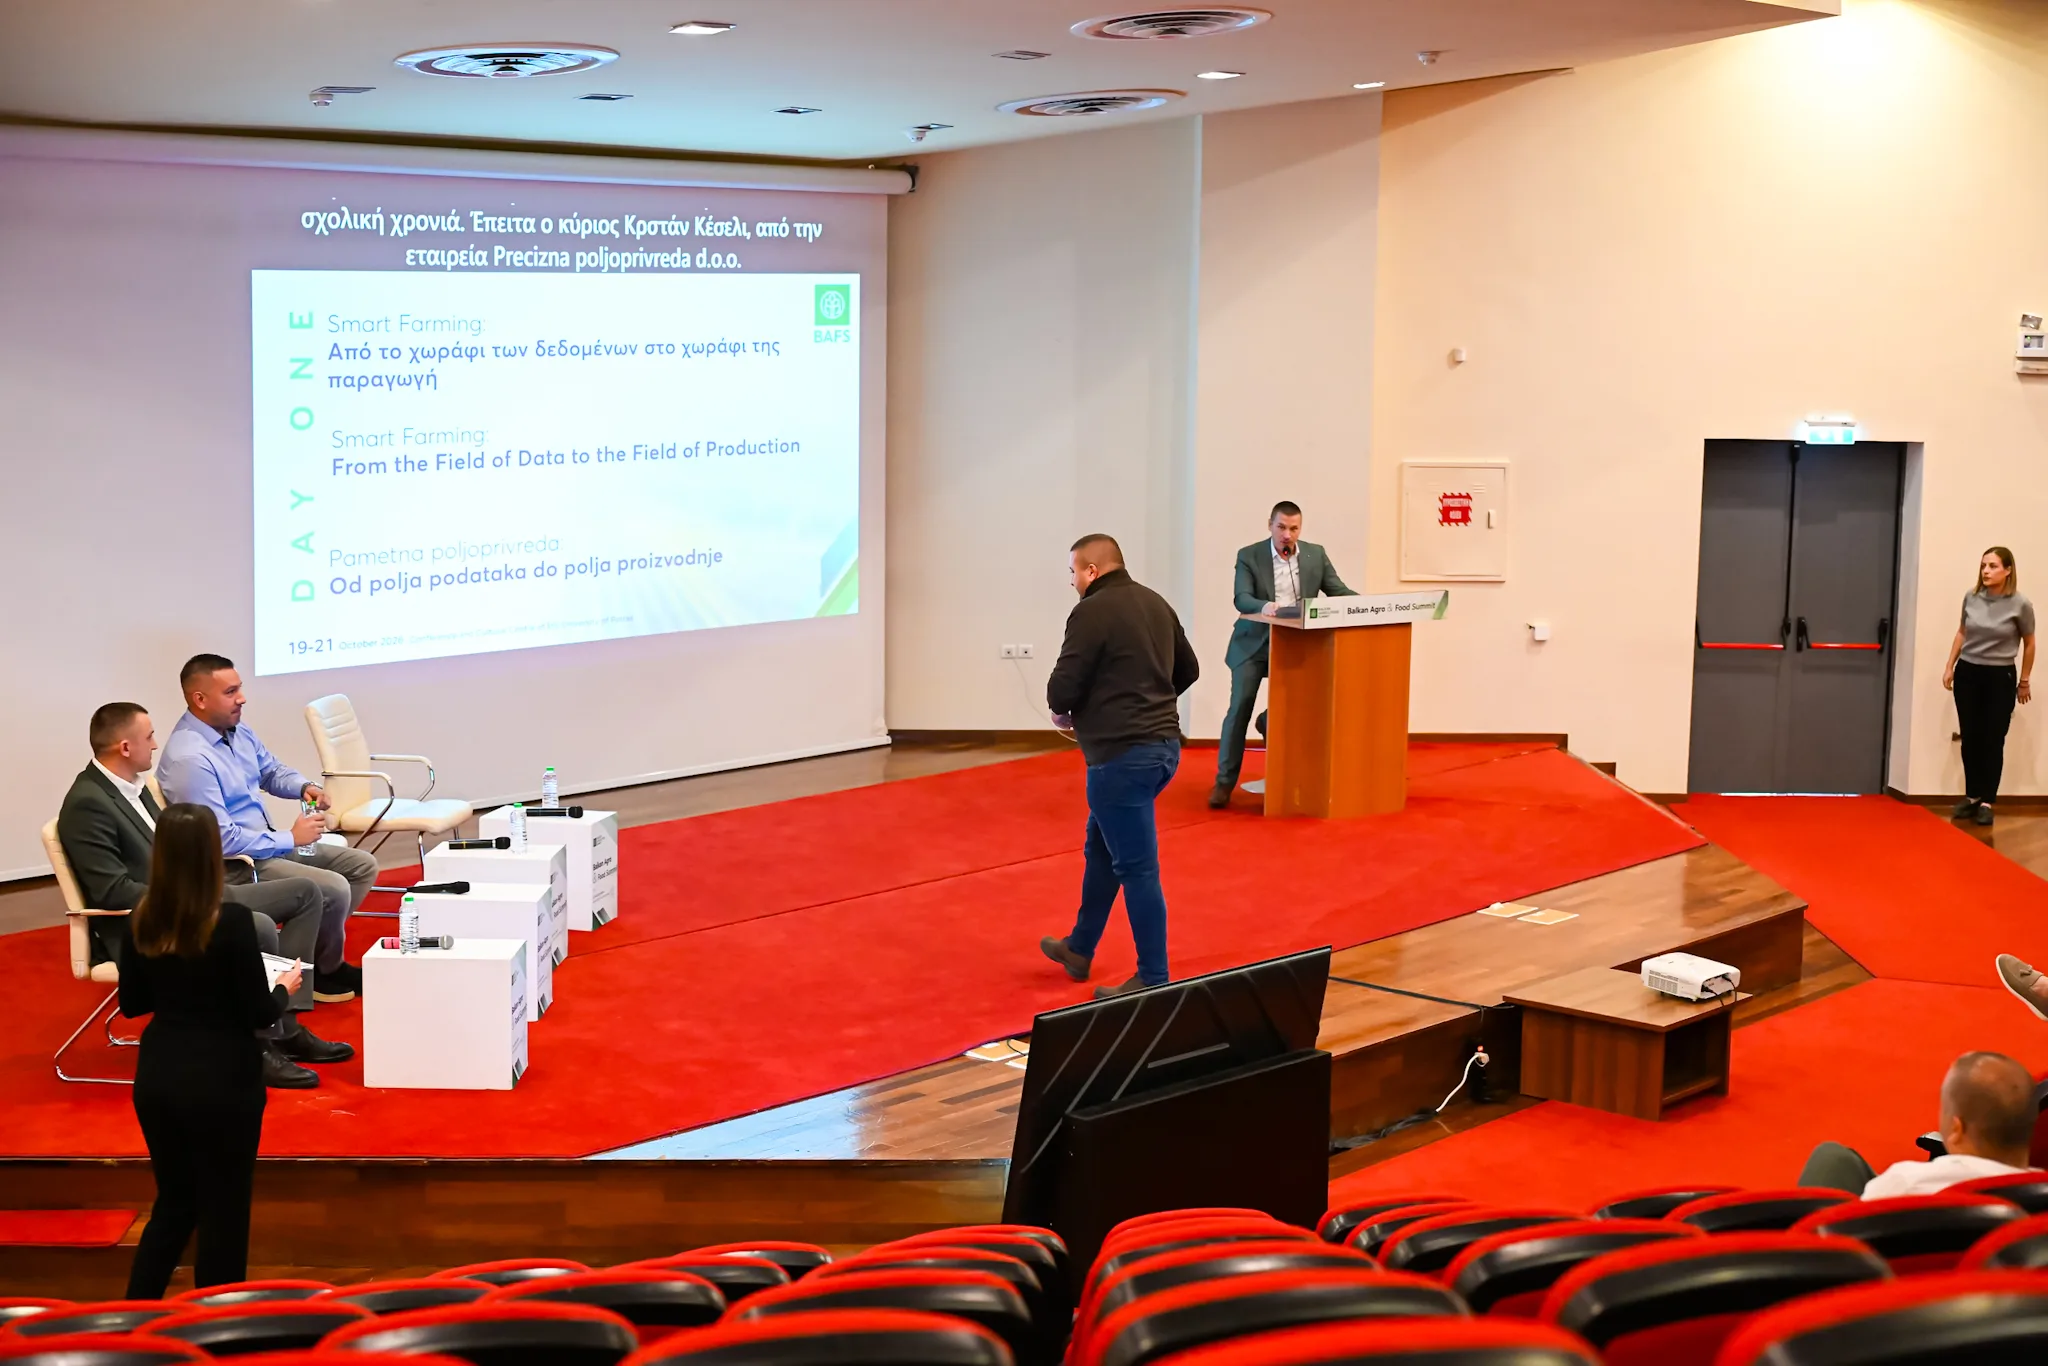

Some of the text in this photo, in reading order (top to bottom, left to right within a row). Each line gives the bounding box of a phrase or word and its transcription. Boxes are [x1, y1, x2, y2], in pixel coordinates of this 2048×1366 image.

[301, 206, 822, 243] σχολική χρονιά. Έπειτα ο κύριος Κρστάν Κέσελι, από την
[405, 243, 742, 273] εταιρεία Precizna poljoprivreda d.o.o.
[327, 314, 486, 337] Smart Farming:
[813, 329, 851, 343] BAFS
[328, 338, 780, 364] Από το χωράφι των δεδομένων στο χωράφι της
[328, 368, 438, 392] παραγωγή
[332, 427, 490, 449] Smart Farming:
[290, 310, 315, 602] DAY ONE
[333, 438, 801, 476] From the Field of Data to the Field of Production
[330, 547, 424, 567] Pametna
[330, 548, 723, 596] Od polja podataka do polja proizvodnje
[1347, 606, 1369, 615] Balkan
[1370, 605, 1386, 615] Agro
[1395, 603, 1410, 612] Food
[1412, 602, 1436, 611] Summit
[289, 638, 333, 655] 19-21
[339, 640, 378, 650] October
